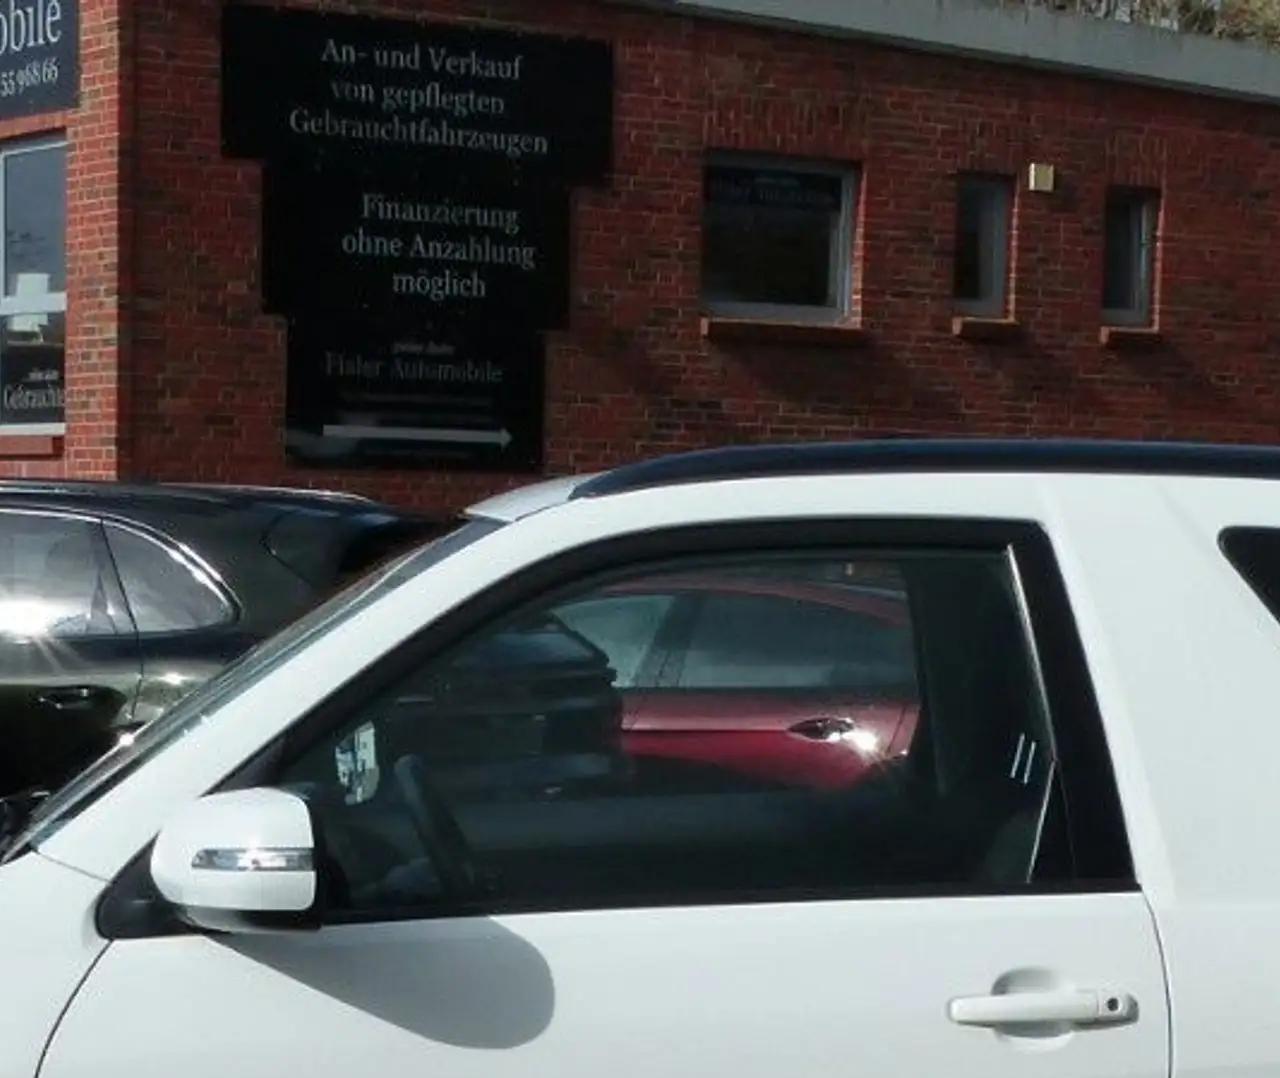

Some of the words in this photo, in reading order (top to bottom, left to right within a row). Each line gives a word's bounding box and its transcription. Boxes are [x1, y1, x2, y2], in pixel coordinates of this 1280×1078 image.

[321, 38, 367, 64] An-
[375, 44, 420, 70] und
[429, 47, 523, 80] Verkauf
[330, 81, 375, 104] von
[381, 82, 505, 117] gepflegten
[288, 108, 549, 156] Gebrauchtfahrzeugen
[361, 193, 522, 235] Finanzierung
[341, 227, 404, 257] ohne
[408, 231, 538, 270] Anzahlung
[392, 268, 487, 301] möglich
